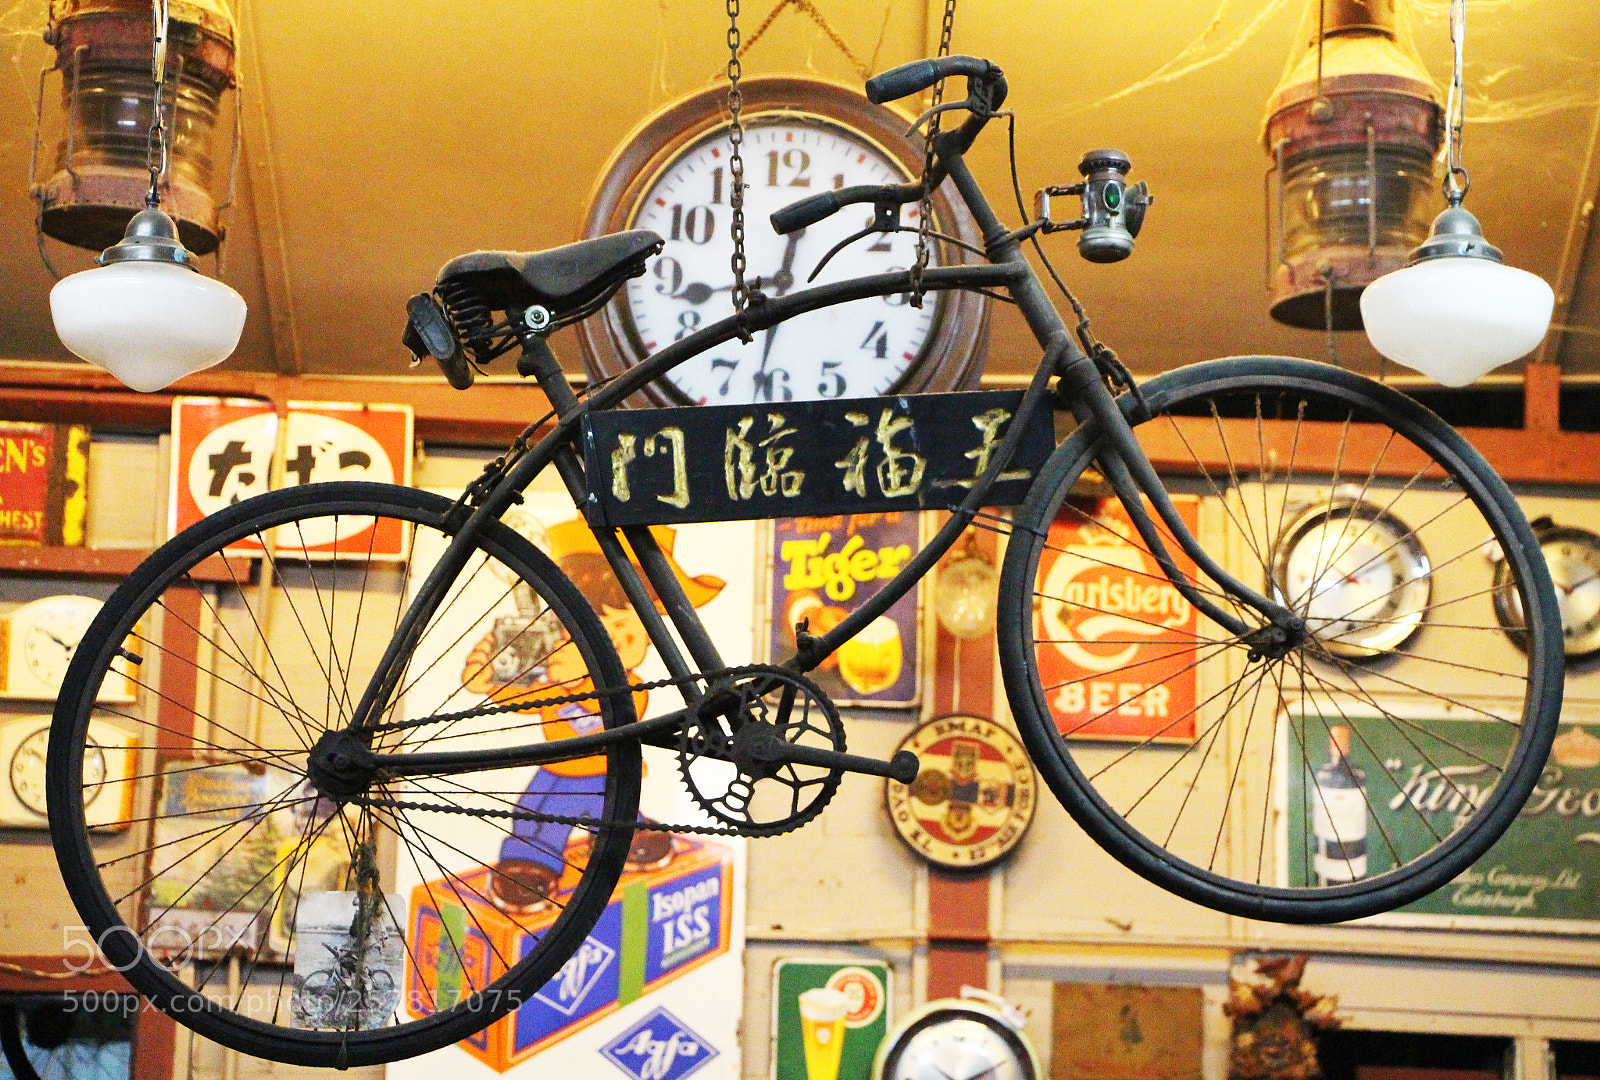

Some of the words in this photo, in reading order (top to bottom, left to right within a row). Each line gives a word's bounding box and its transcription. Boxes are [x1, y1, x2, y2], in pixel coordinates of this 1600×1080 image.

[764, 148, 811, 188] 12
[670, 203, 716, 245] 10
[653, 256, 684, 296] 9
[860, 320, 890, 359] 4
[711, 358, 740, 397] 7
[763, 367, 793, 402] 6
[817, 361, 847, 398] 5
[781, 531, 911, 601] Tiger
[1041, 543, 1190, 672] Carlsberg
[1054, 680, 1171, 717] BEER
[652, 877, 719, 922] Isopan
[662, 904, 711, 955] ISS
[614, 1028, 699, 1080] Agfa
